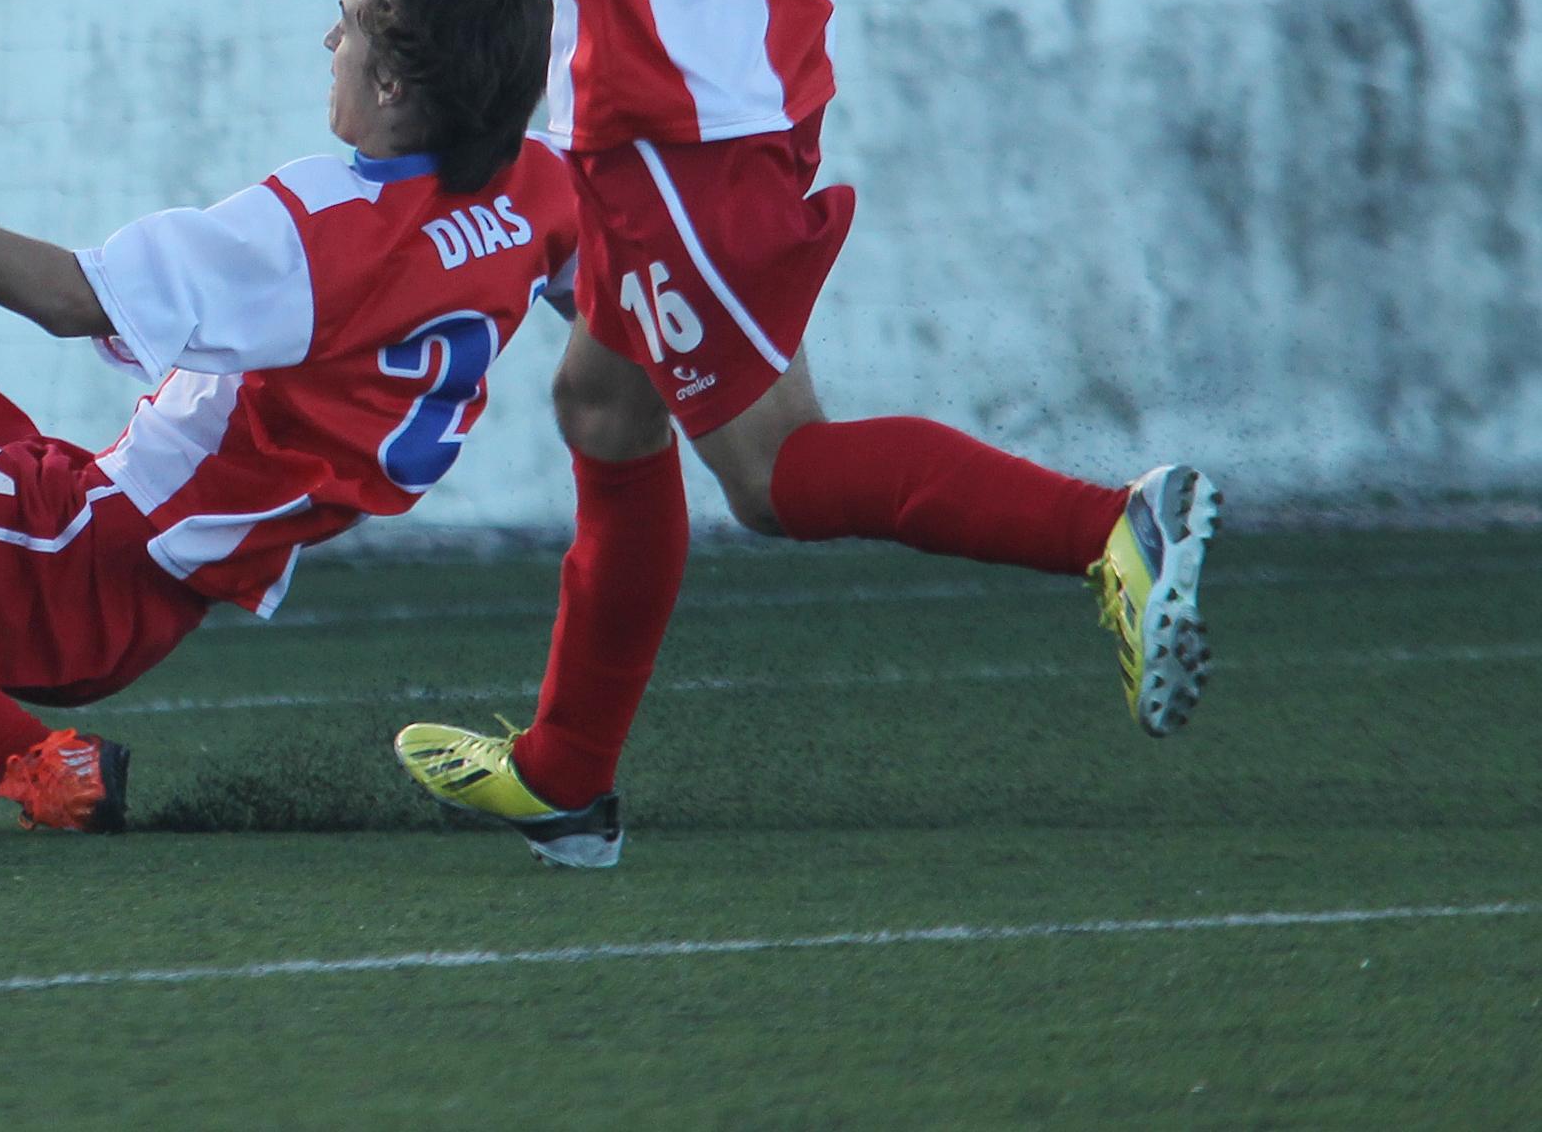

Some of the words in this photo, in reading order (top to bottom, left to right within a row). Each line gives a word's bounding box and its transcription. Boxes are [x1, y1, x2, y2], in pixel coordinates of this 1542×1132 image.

[422, 195, 533, 270] DIAS
[620, 261, 704, 364] 16
[378, 275, 549, 494] 2
